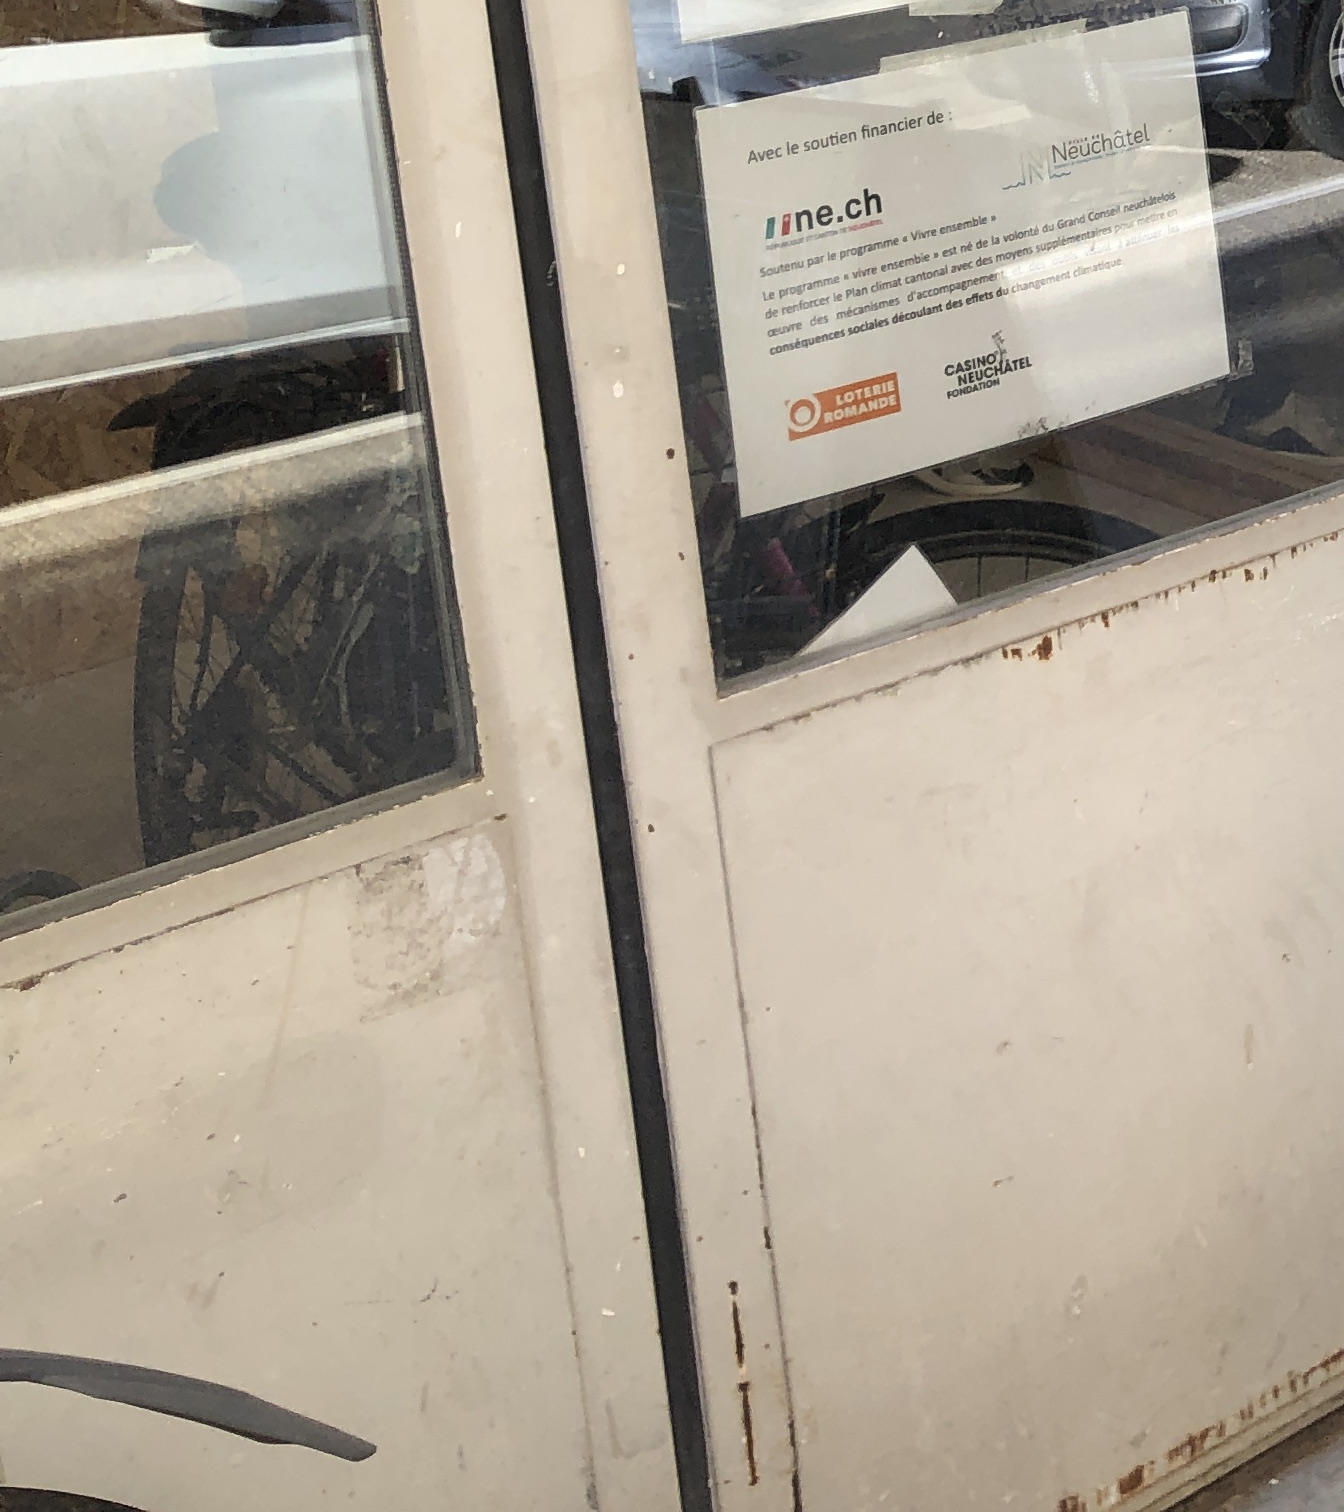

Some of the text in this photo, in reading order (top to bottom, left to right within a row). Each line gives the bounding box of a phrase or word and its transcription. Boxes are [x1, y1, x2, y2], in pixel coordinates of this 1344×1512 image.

[747, 146, 783, 165] Avec
[786, 141, 800, 156] le
[803, 131, 858, 152] soutien
[860, 116, 923, 140] financier
[926, 110, 944, 126] de
[794, 188, 883, 233] ne.ch
[759, 260, 805, 278] Soutenu
[806, 254, 825, 269] par
[827, 251, 837, 262] le
[839, 237, 900, 261] programme
[910, 228, 937, 241] Vivre
[939, 215, 988, 235] ensemble
[762, 291, 775, 302] Le
[778, 275, 840, 300] programme
[851, 266, 878, 279] vivre
[880, 252, 931, 273] ensemble
[941, 246, 958, 258] est
[960, 240, 973, 254] né
[975, 238, 989, 250] de
[990, 235, 1001, 246] la
[1002, 225, 1040, 243] volonté
[1041, 223, 1055, 234] du
[1056, 213, 1086, 230] Grand
[1087, 204, 1121, 222] Conseil
[1123, 191, 1177, 213] neuchâtelois
[764, 307, 779, 320] de
[781, 296, 831, 316] renforcer
[832, 292, 843, 302] le
[845, 286, 869, 300] Plan
[870, 277, 903, 293] climat
[904, 264, 949, 285] cantonal
[950, 260, 974, 274] avec
[975, 256, 994, 268] des
[995, 246, 1034, 263] moyens
[1035, 226, 1113, 253] supplémentaires
[1166, 208, 1178, 218] en
[767, 321, 803, 338] œuvre
[809, 315, 829, 327] des
[835, 297, 901, 320] mécanismes
[769, 258, 1122, 356] conséquences sociales découlant des effets du changement climatique
[943, 353, 997, 377] CASINO
[957, 356, 1033, 386] NEUCHÂTEL
[823, 395, 897, 424] ROMANDE
[836, 380, 896, 406] LOTERIE
[946, 378, 1000, 399] FONDATION
